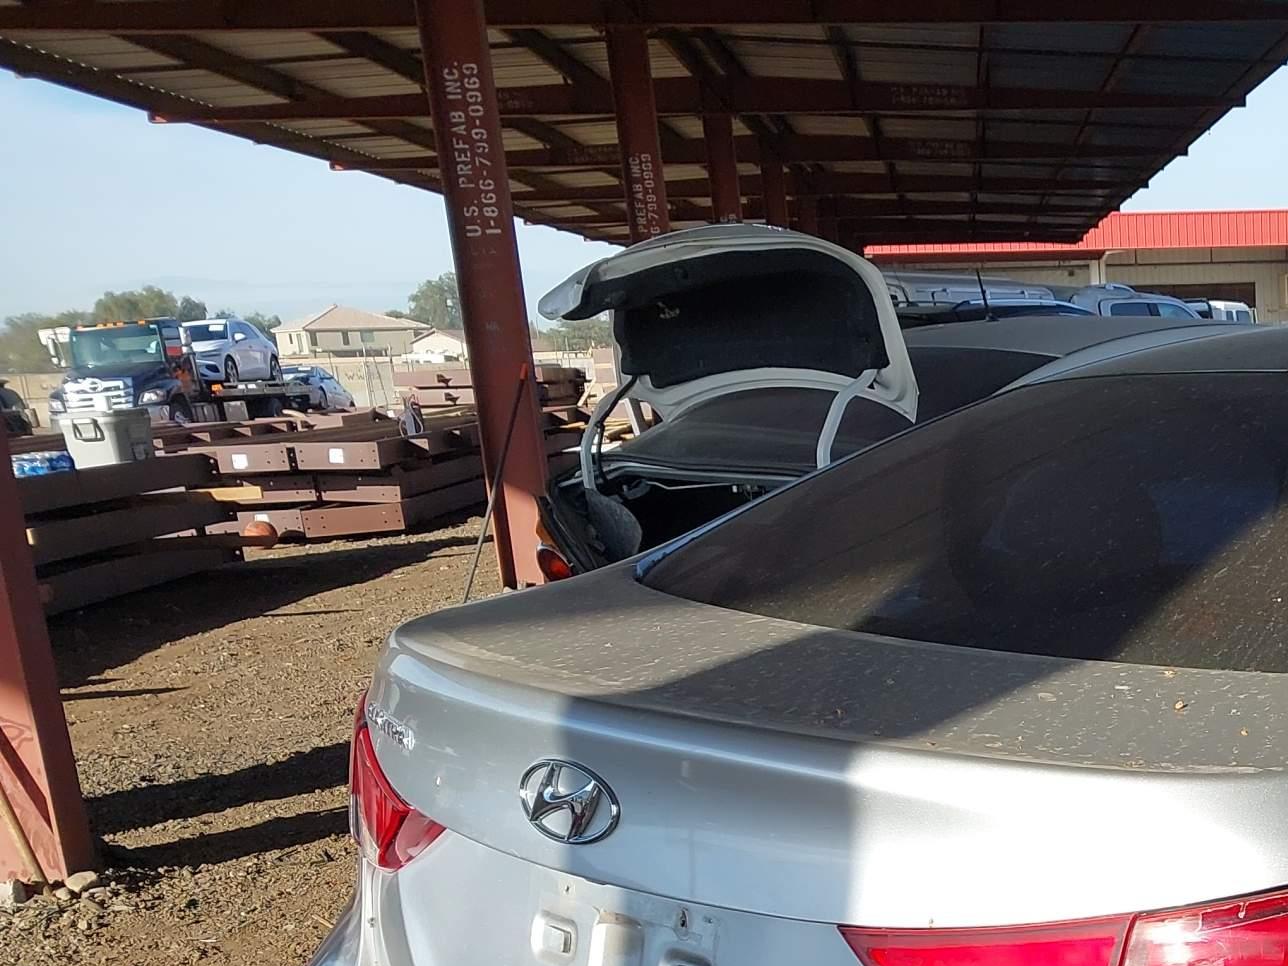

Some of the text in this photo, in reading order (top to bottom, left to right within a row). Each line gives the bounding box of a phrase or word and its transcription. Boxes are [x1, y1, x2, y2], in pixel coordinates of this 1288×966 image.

[443, 61, 482, 237] U.S. PREFAB INC.
[462, 63, 502, 235] 1-866-799-0969
[632, 183, 648, 233] PREFAB
